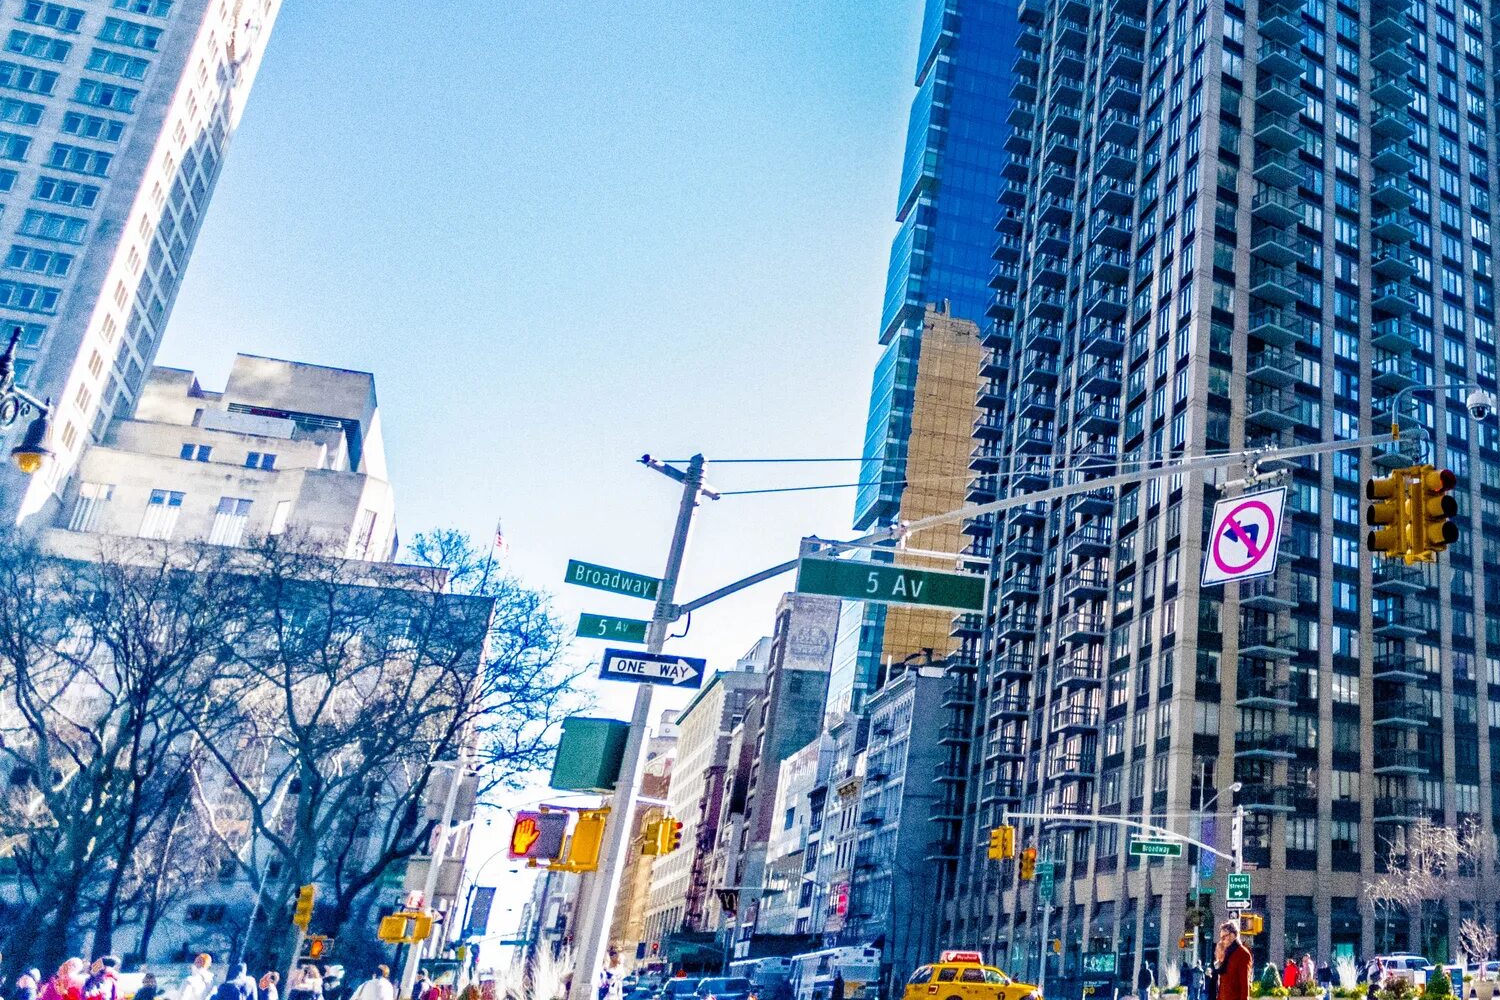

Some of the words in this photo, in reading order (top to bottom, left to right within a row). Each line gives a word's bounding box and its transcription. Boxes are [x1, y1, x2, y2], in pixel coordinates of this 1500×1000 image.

[575, 564, 651, 597] Broadway
[866, 571, 879, 593] 5
[597, 618, 608, 636] 5
[616, 659, 647, 674] ONE
[659, 663, 689, 678] WAY
[1142, 844, 1170, 855] Broadway
